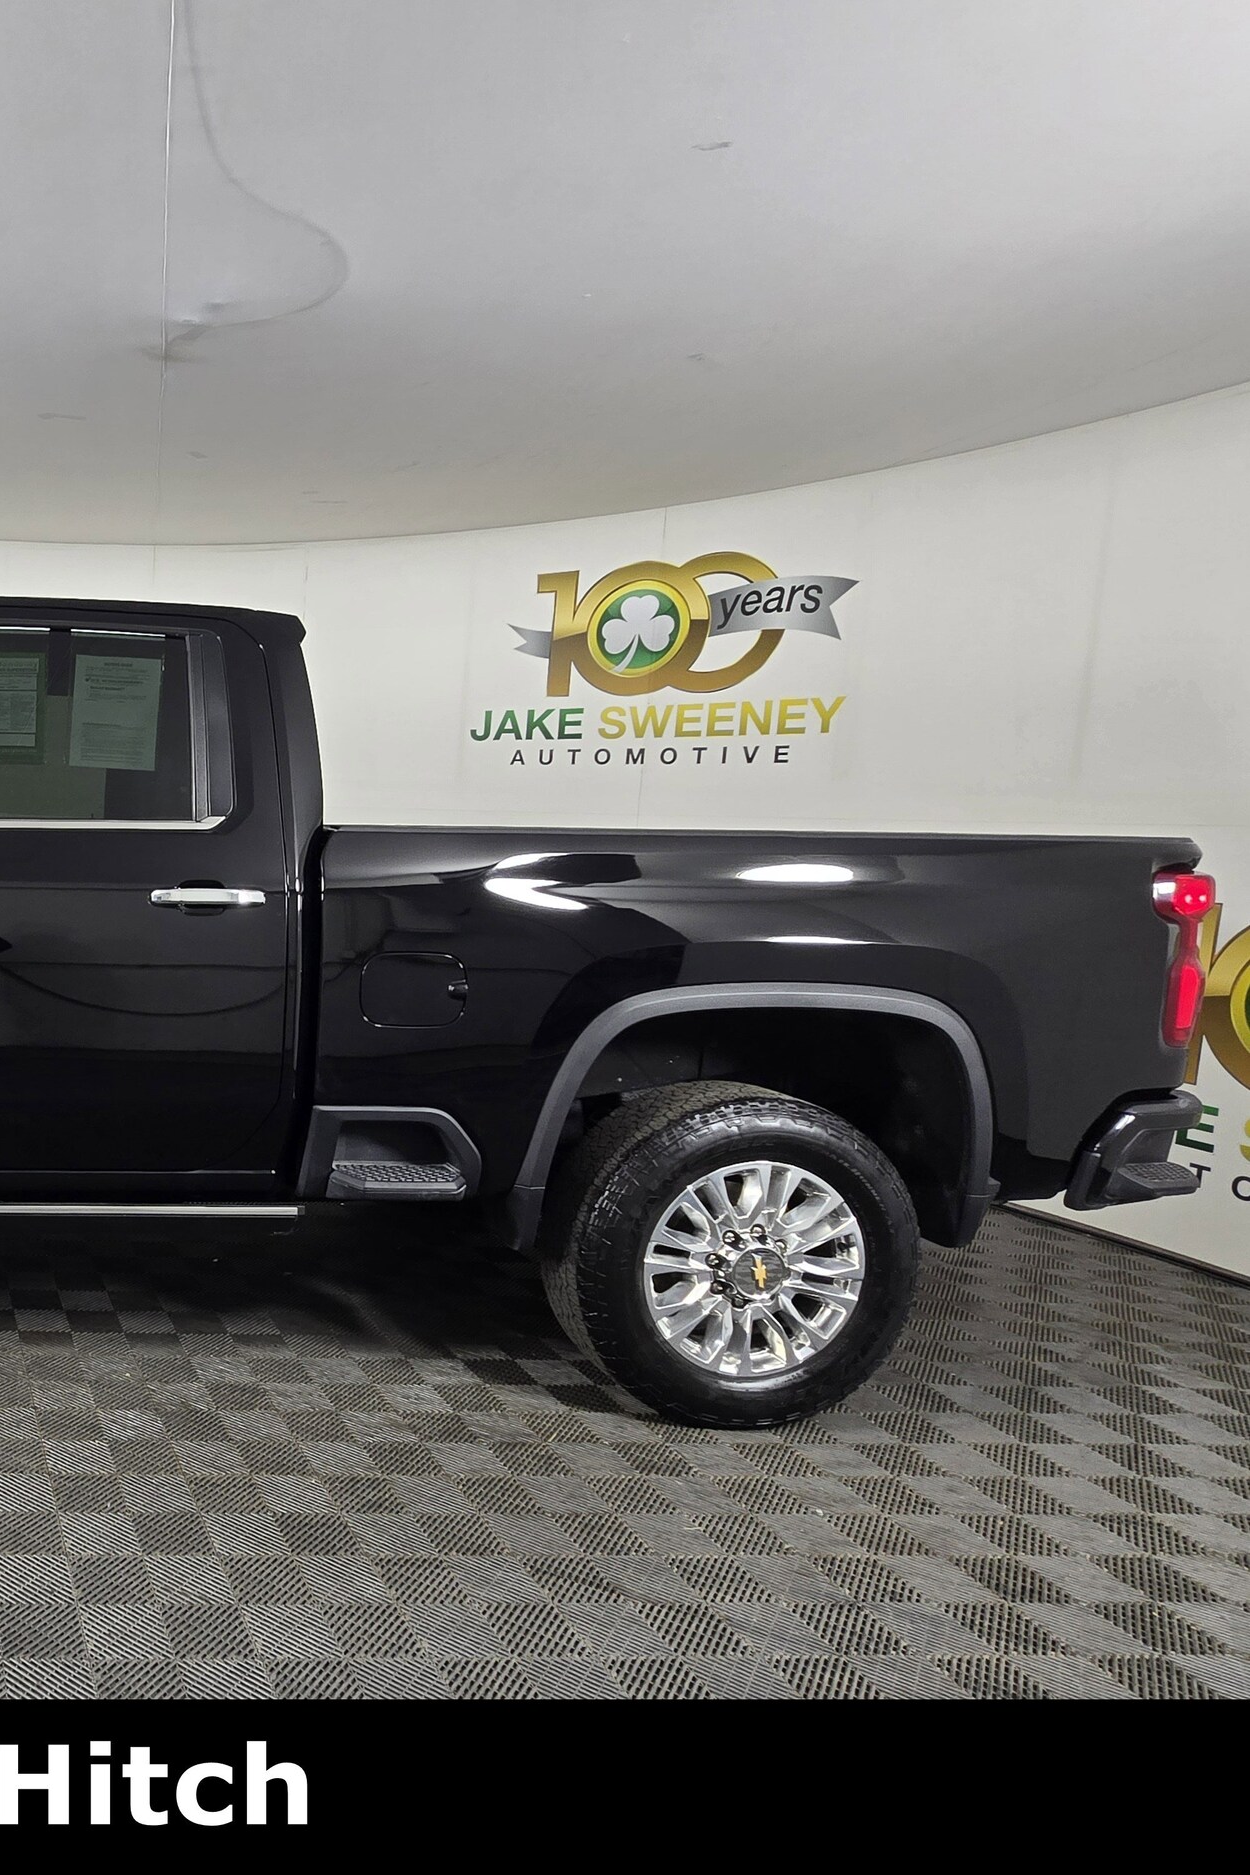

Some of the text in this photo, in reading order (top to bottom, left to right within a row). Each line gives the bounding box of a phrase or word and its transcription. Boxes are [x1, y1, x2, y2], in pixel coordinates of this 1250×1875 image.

[537, 551, 823, 698] 100 years
[470, 696, 847, 742] JAKE SWEENEY
[510, 745, 791, 766] AUTOMOTIVE
